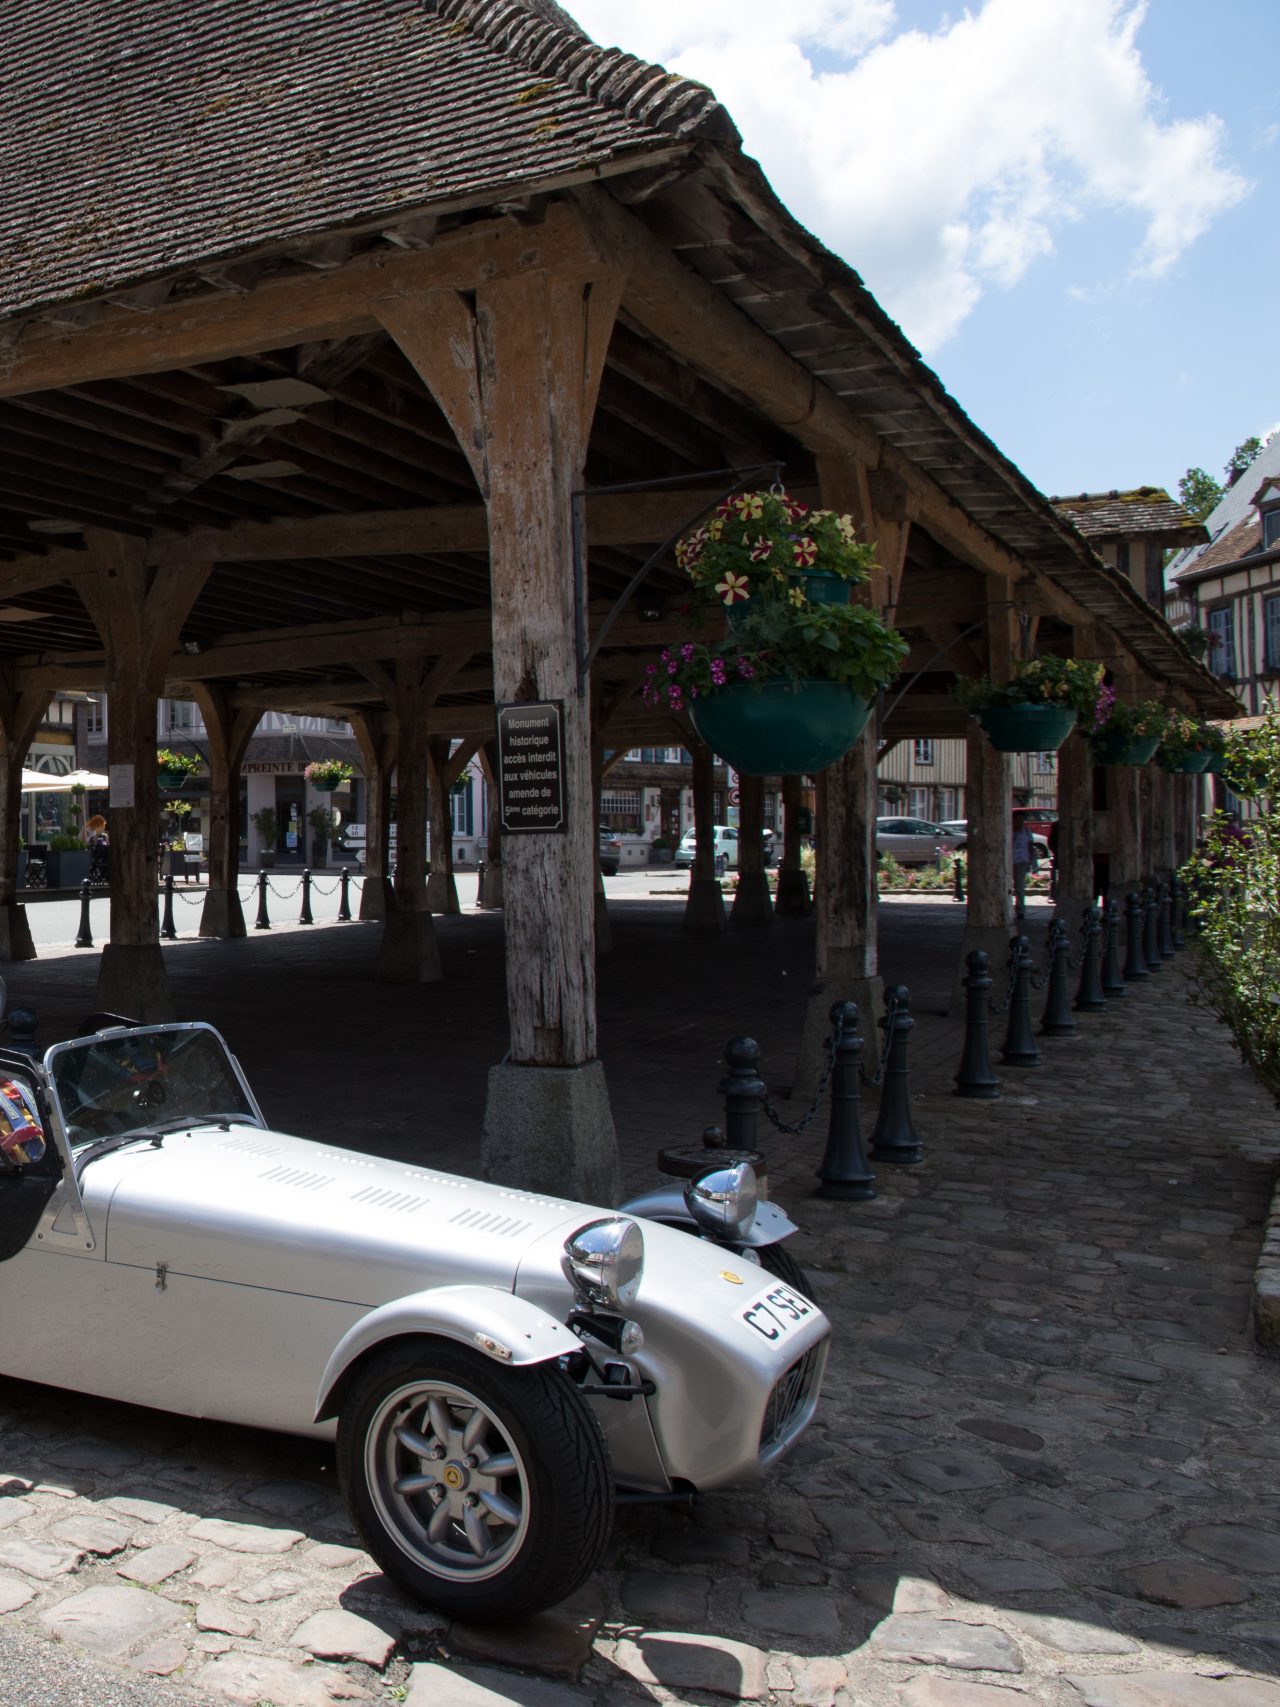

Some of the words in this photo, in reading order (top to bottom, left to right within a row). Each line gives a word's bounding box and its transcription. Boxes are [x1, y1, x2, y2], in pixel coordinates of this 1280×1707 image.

[508, 717, 550, 729] Monument
[509, 735, 549, 748] historique
[503, 752, 527, 764] accès
[528, 751, 557, 763] interdit
[504, 773, 518, 781] aux
[519, 769, 558, 781] véhicules
[508, 787, 540, 799] amende
[541, 787, 551, 797] de
[521, 804, 560, 818] catégorie
[742, 1301, 787, 1341] C7
